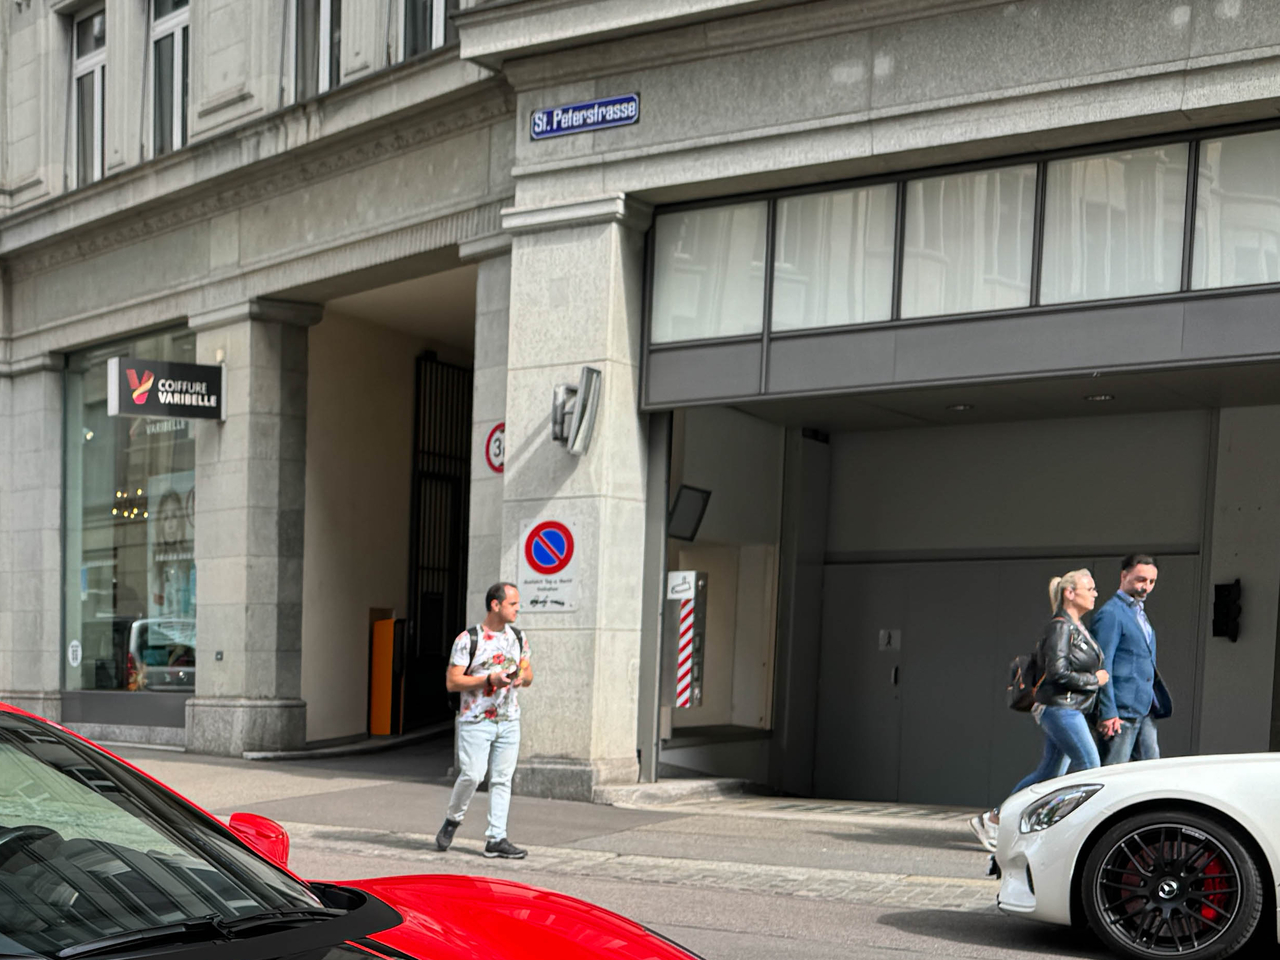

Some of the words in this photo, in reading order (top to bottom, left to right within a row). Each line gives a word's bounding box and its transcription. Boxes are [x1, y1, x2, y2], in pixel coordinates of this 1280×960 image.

[533, 111, 551, 133] St.
[552, 101, 636, 130] Peterstrasse
[158, 379, 207, 394] COIFFURE
[158, 392, 217, 407] VARIBELLE
